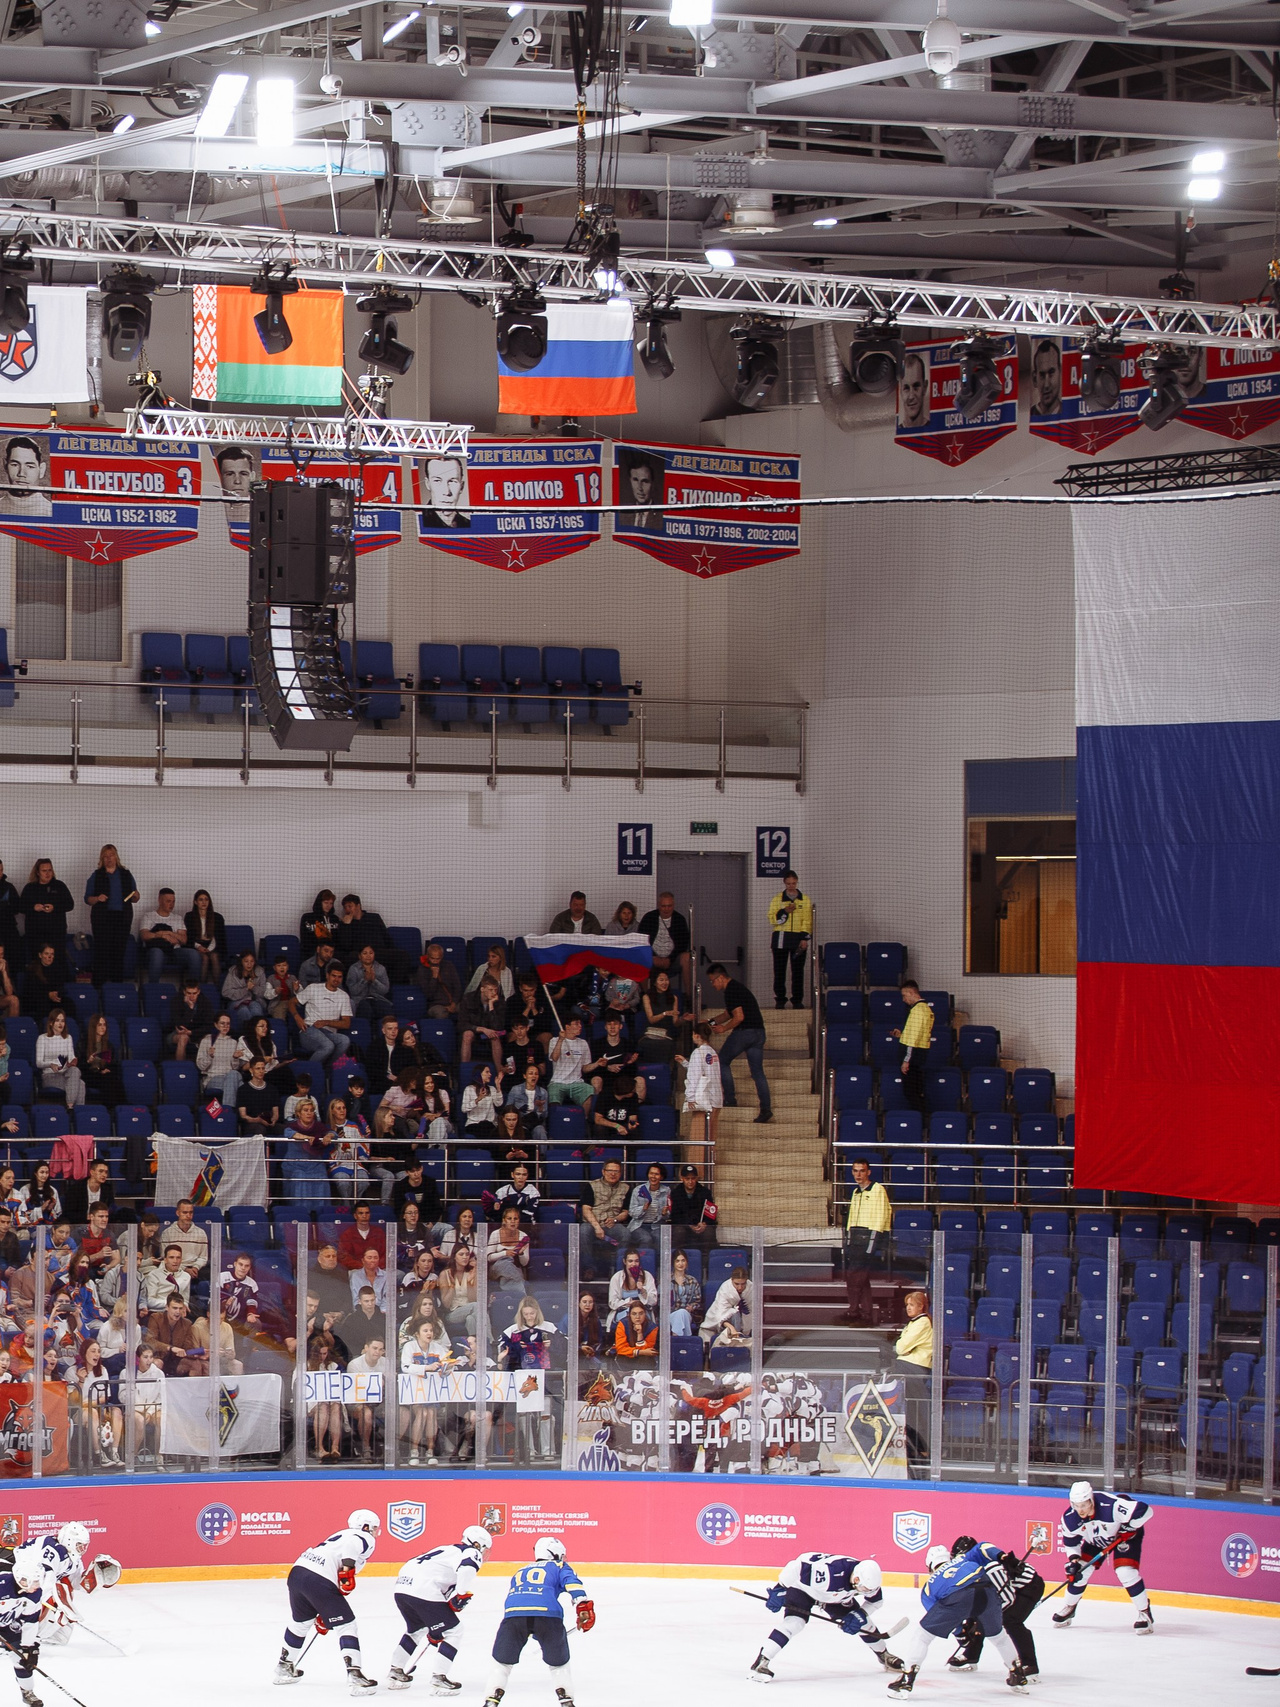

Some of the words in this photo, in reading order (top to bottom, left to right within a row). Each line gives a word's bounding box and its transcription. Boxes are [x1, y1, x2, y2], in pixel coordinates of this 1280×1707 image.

[1228, 382, 1249, 399] ЦСКА
[1251, 379, 1272, 393] 1954
[944, 413, 963, 428] ЦСКА
[57, 436, 138, 453] ЛЕГЕНДЫ
[145, 441, 191, 455] ЦСКА
[473, 448, 547, 464] ЛЕГЕНДЫ
[553, 447, 596, 462] ЦСКА
[671, 455, 744, 473] ЛЕГЕНДЫ
[749, 460, 792, 476] ЦСКА
[85, 470, 166, 493] ТРЕГУБОВ
[176, 465, 194, 497] 3
[382, 470, 398, 503] 4
[483, 481, 500, 502] Л.
[503, 479, 564, 501] ВОЛКОВ
[573, 471, 601, 505] 18
[81, 507, 111, 524] ЦСКА
[115, 508, 178, 524] 1952-1962
[496, 516, 527, 532] ЦСКА
[529, 514, 585, 531] 1957-1965
[665, 521, 692, 536] ЦСКА
[694, 524, 744, 540] 1977-1996,
[747, 528, 797, 541] 2002-2004
[622, 828, 648, 856] 11
[759, 830, 788, 858] 12
[622, 858, 648, 868] сектор
[760, 861, 787, 871] сектор
[305, 1374, 382, 1403] ВПЕРЁД
[401, 1372, 518, 1403] МАЛАХОВКА
[240, 1511, 291, 1522] МОСКВА
[393, 1507, 420, 1515] МСХЛ
[565, 1511, 589, 1519] СВЯЗЕЙ
[517, 1518, 563, 1527] МОЛОДЁЖНОЙ
[744, 1514, 797, 1526] МОСКВА
[899, 1517, 926, 1526] МСХЛ
[537, 1526, 565, 1534] МОСКВЫ
[815, 1570, 826, 1584] 25
